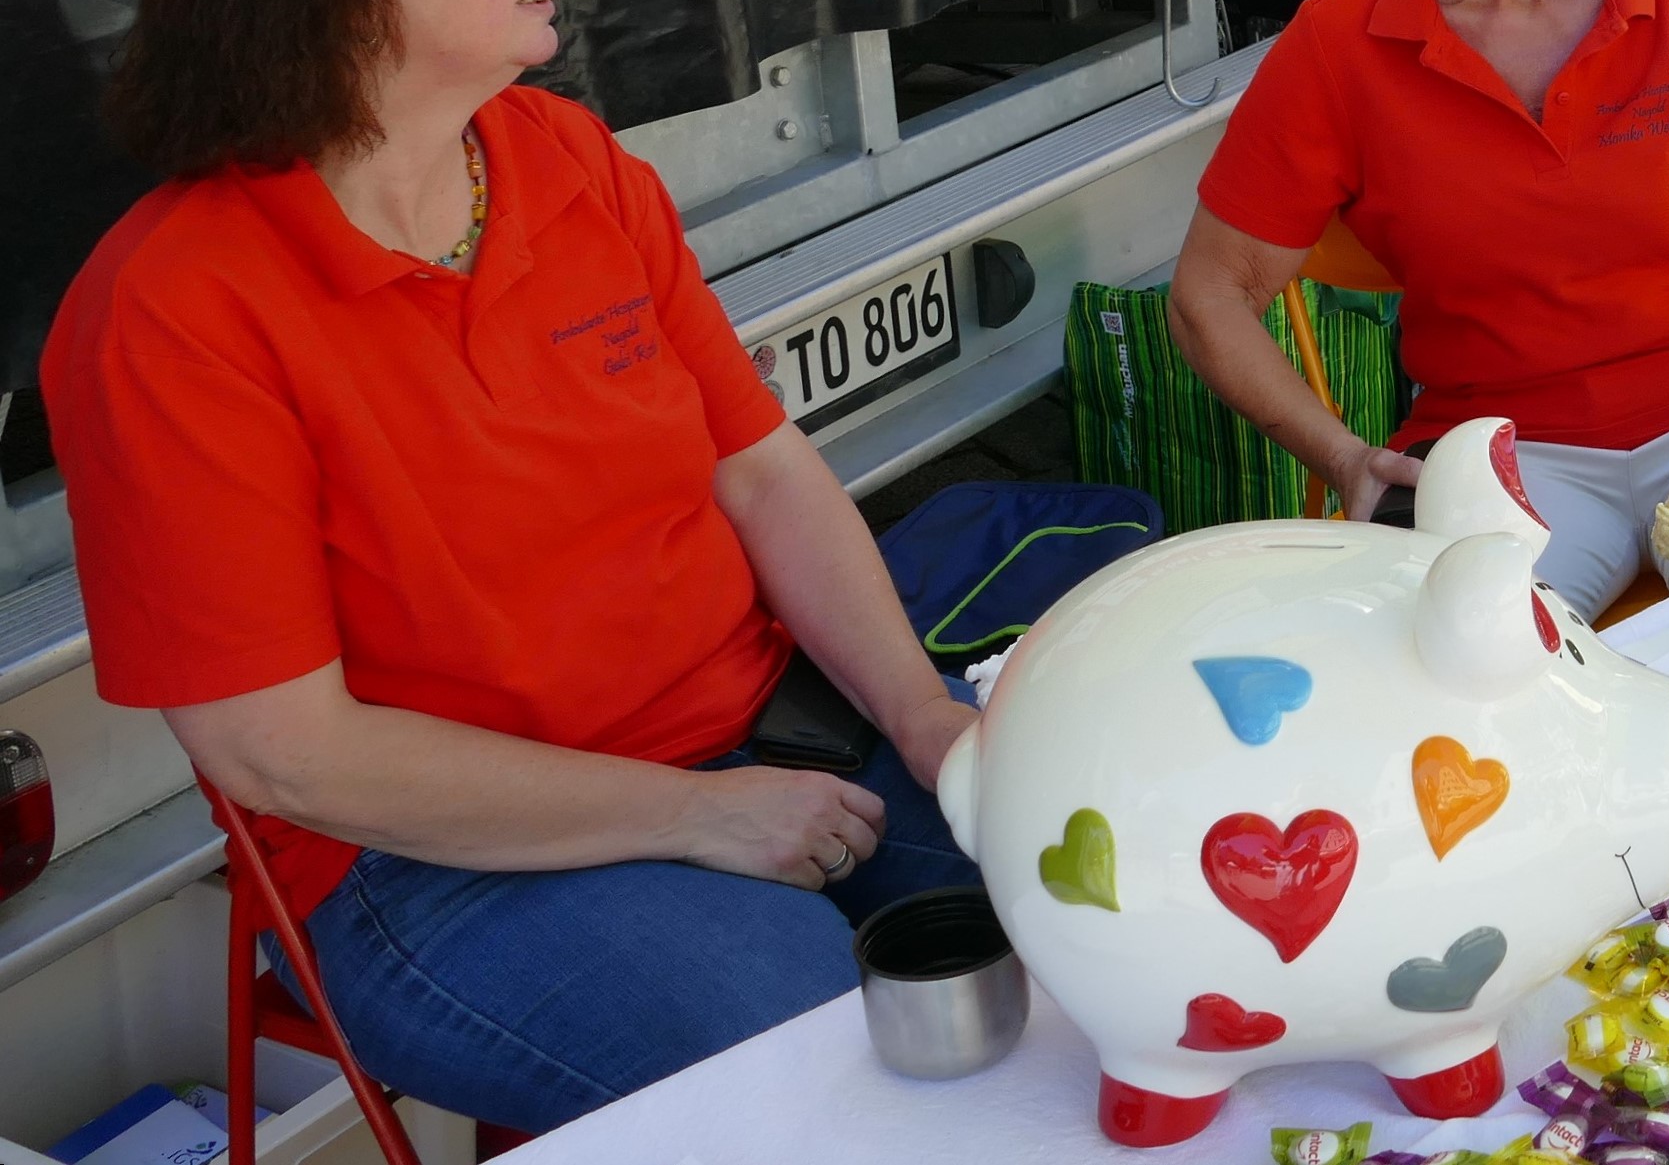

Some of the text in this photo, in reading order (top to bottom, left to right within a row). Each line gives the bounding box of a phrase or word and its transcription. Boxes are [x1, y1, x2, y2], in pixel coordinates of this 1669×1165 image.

[786, 268, 945, 404] TO 806
[1549, 1119, 1585, 1148] intact
